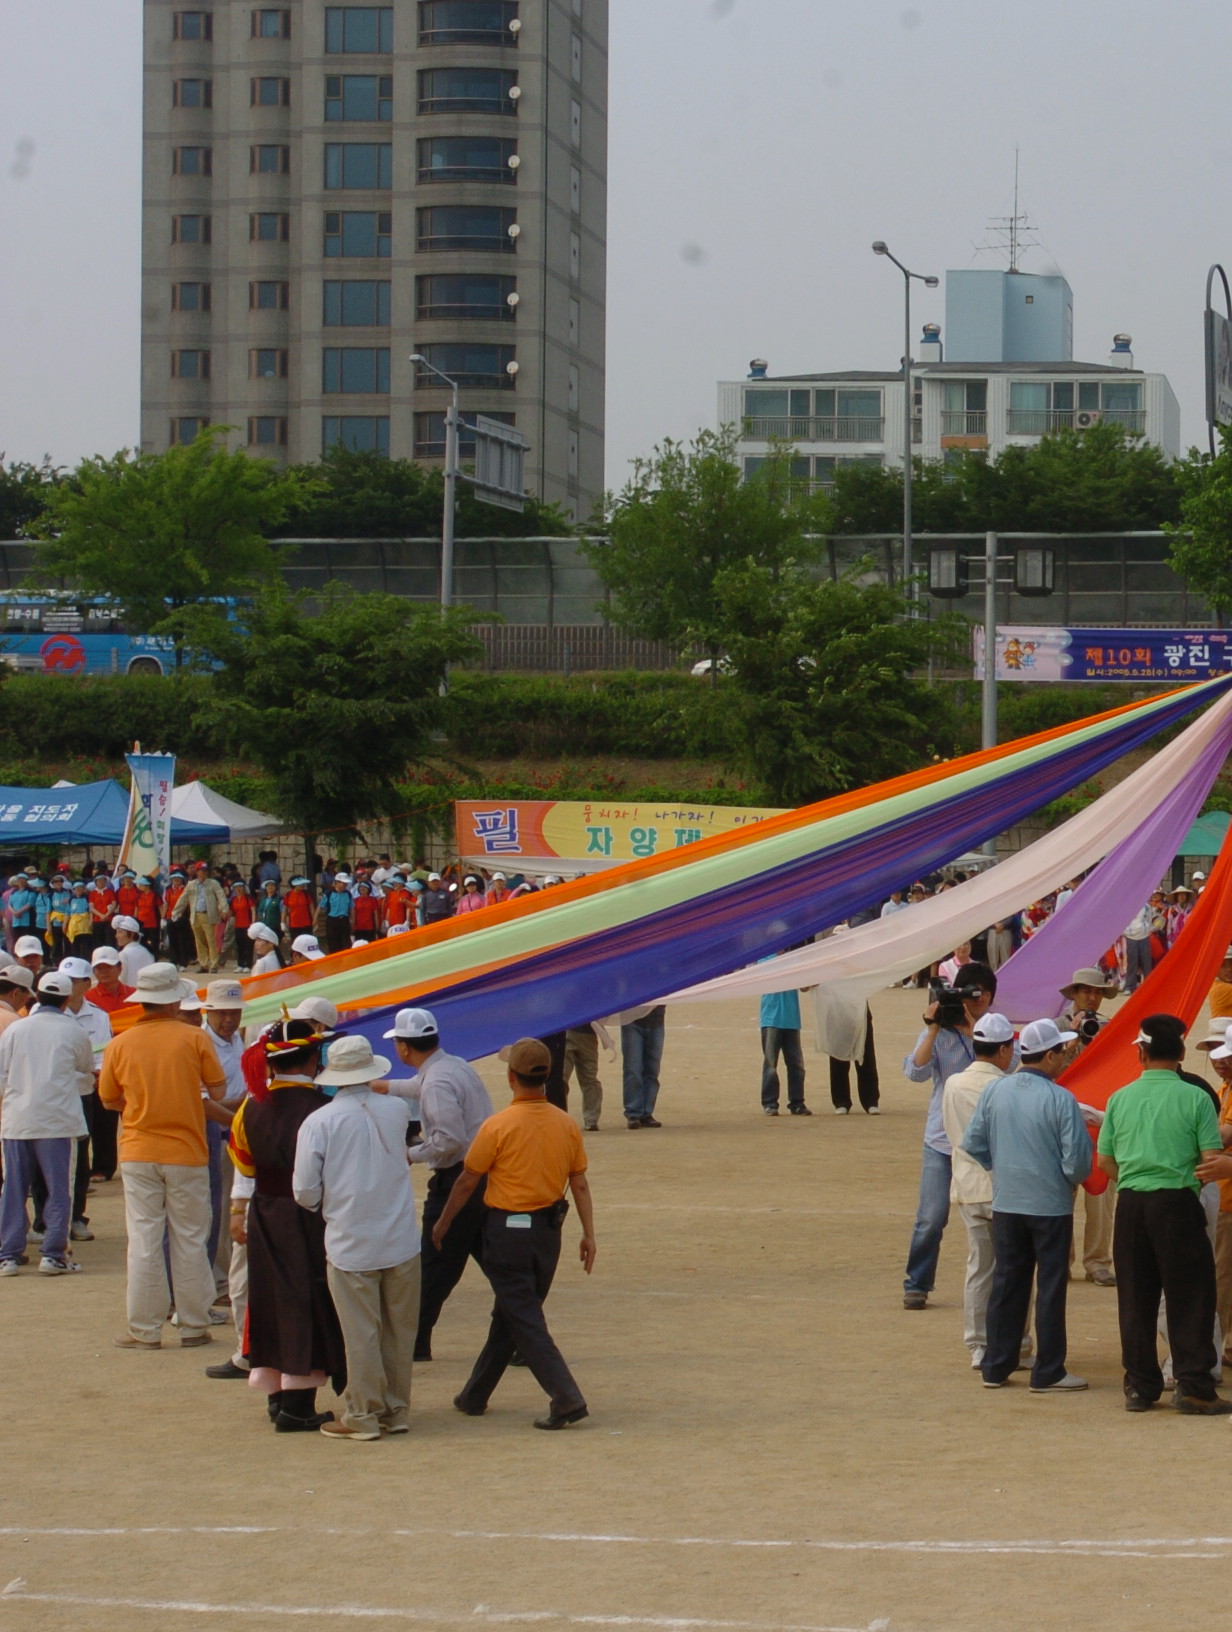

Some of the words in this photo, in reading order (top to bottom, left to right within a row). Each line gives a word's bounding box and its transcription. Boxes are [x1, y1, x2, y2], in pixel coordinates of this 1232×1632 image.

[1086, 648, 1152, 666] 제10회
[1163, 645, 1210, 667] 광진
[472, 808, 522, 853] 필
